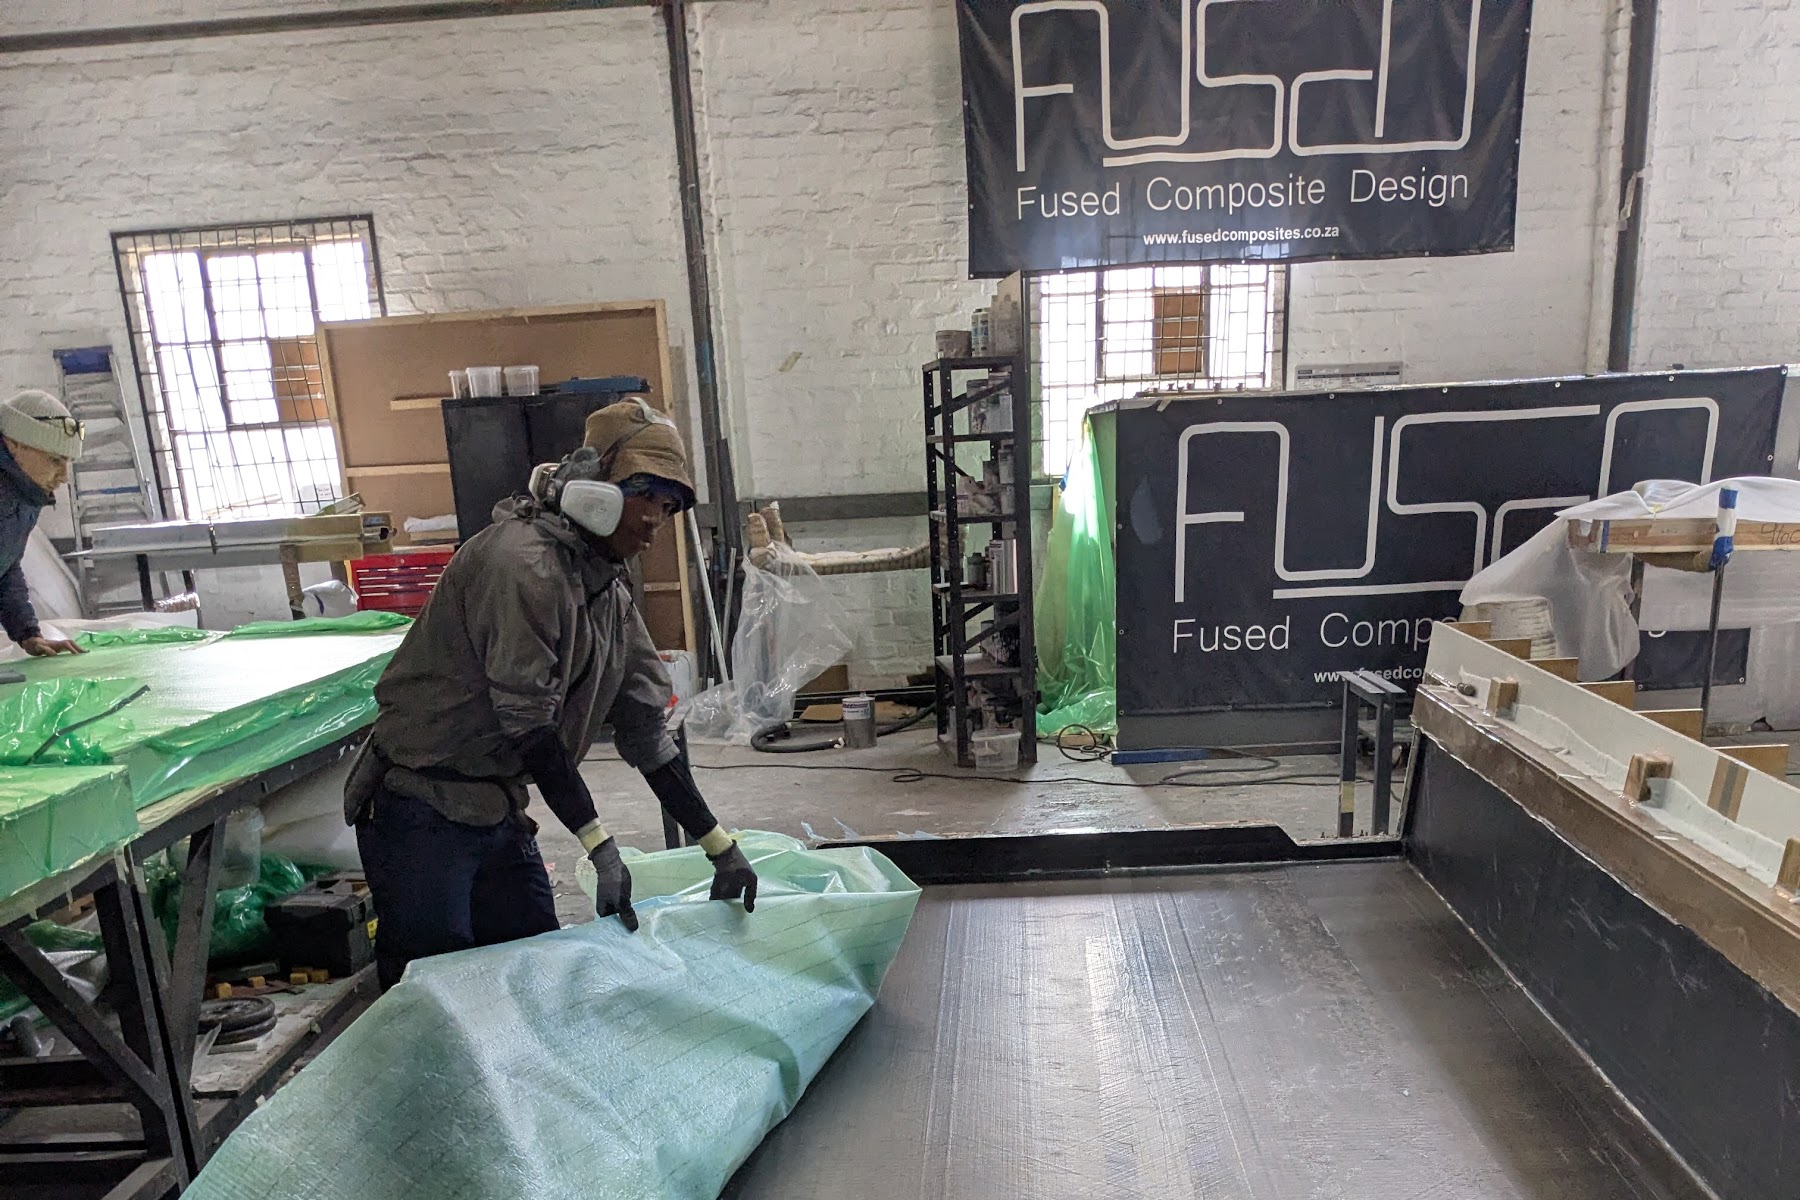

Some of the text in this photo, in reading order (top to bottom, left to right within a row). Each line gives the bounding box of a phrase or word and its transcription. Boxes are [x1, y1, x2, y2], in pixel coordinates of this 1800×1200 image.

[1017, 166, 1468, 220] Fused Composite Design
[1143, 225, 1340, 245] www.fusedcomposites.co.za
[1173, 612, 1457, 653] Fused Comp
